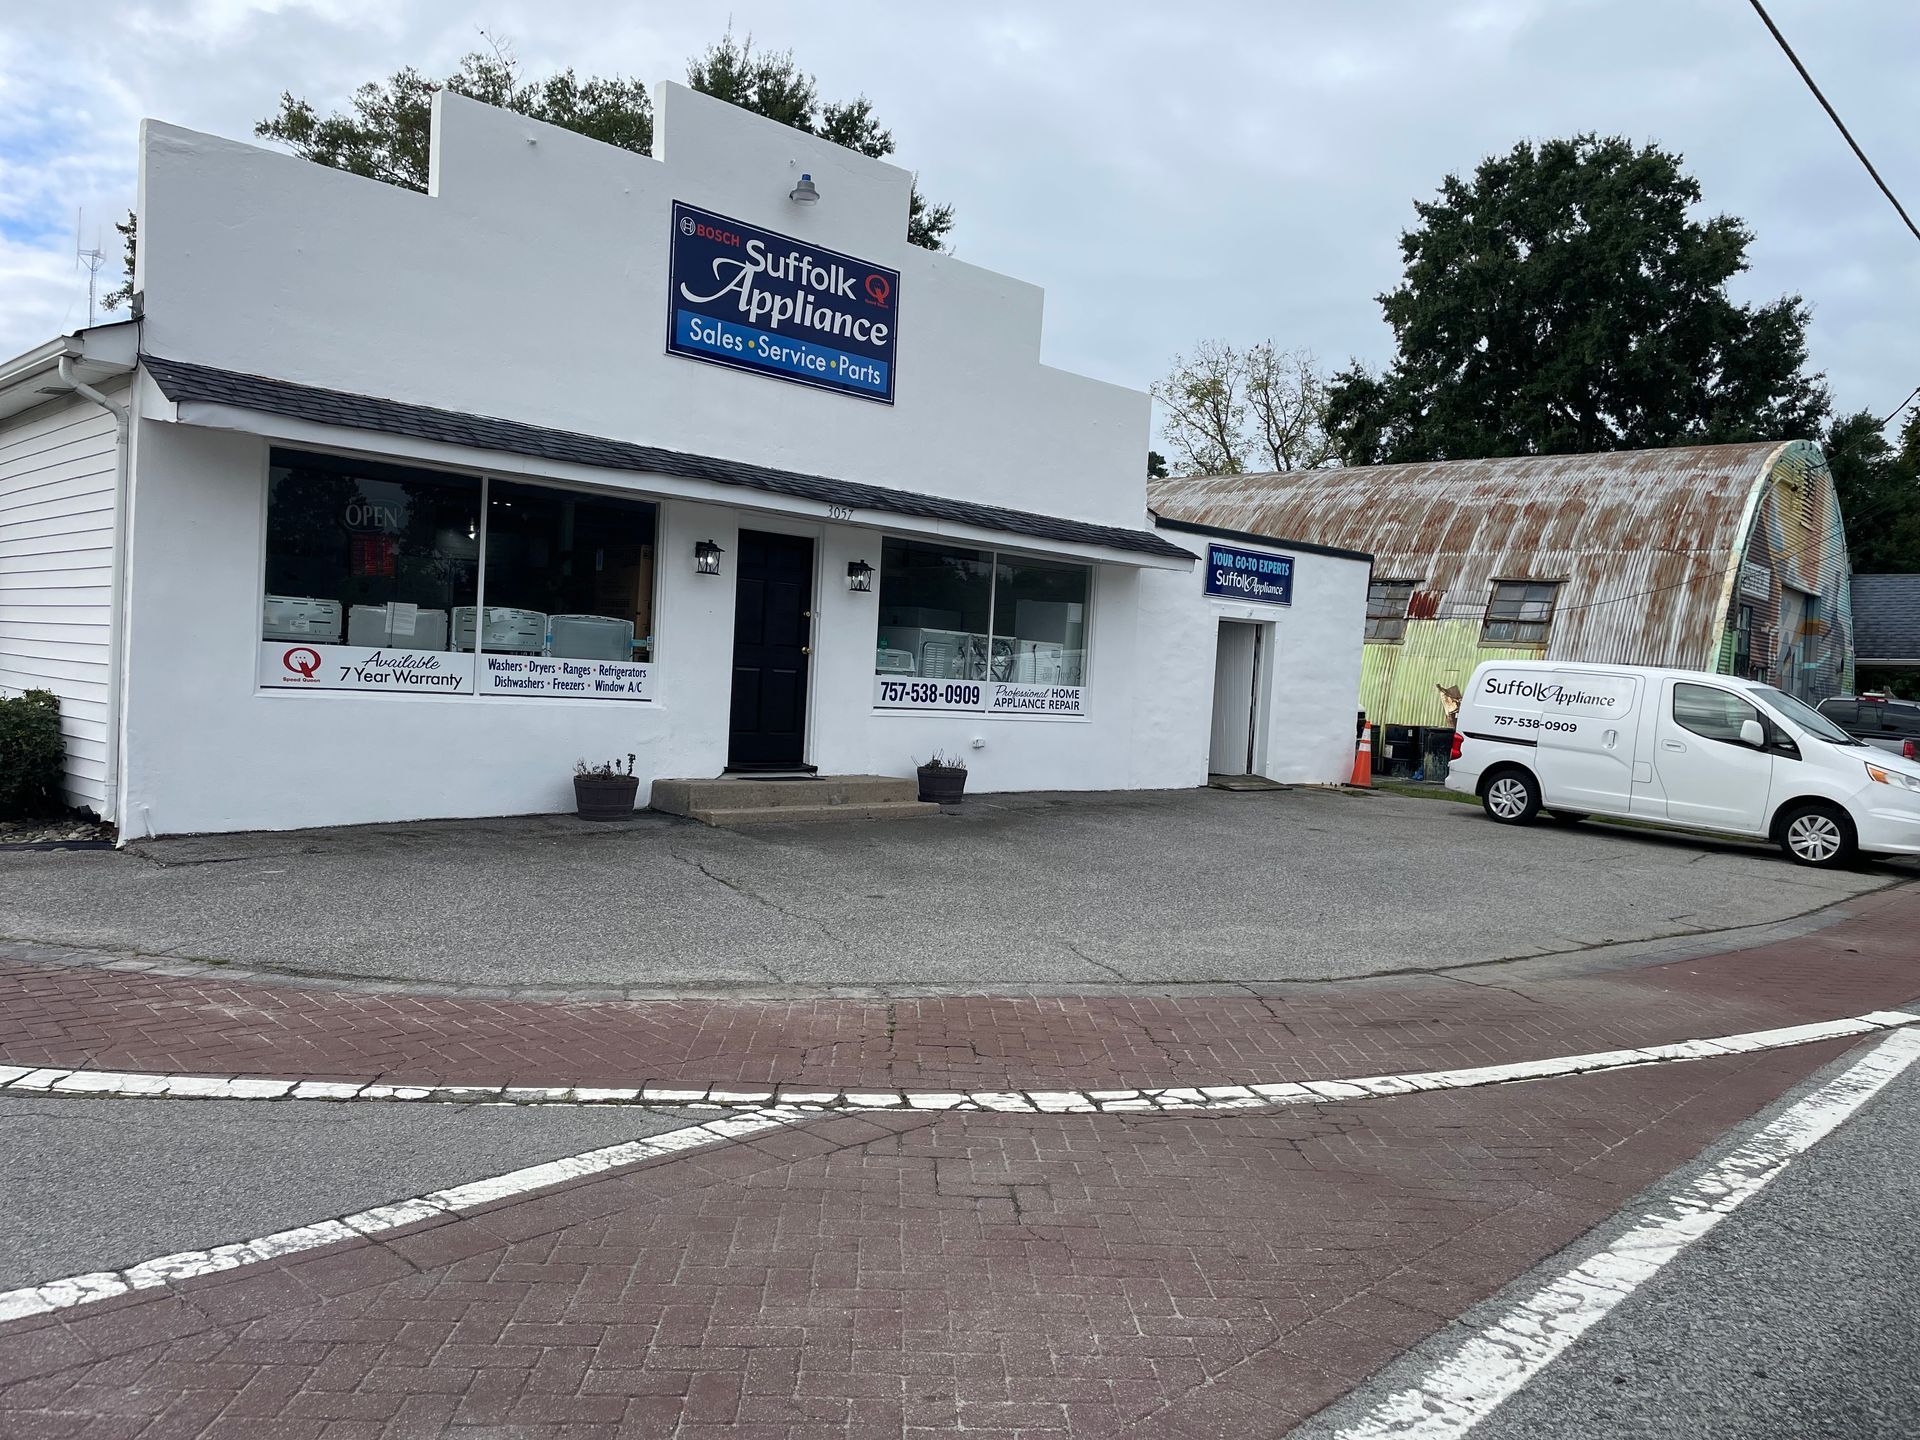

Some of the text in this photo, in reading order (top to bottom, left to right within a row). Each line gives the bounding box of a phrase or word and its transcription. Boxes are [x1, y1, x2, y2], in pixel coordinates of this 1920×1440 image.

[697, 223, 740, 247] BOSCH
[746, 239, 857, 300] Suffolk
[680, 257, 889, 346] Appliance
[689, 317, 881, 385] Sales Service Parts
[345, 504, 398, 528] OPEN
[828, 504, 854, 520] 3057
[1213, 552, 1289, 576] YOUR GO-TO EXPERTS
[1216, 570, 1283, 595] Suffolk Appliance
[361, 650, 441, 671] Available
[488, 658, 647, 680] Washers Dryers Ranges Refrigerators
[340, 666, 463, 691] 7 Year Warranty
[494, 675, 642, 693] Dishwashers Freezers Window A/C
[880, 681, 980, 705] 757-538-0909
[994, 684, 1080, 699] Professional HOME
[1485, 678, 1616, 706] Suffolk Appliance
[993, 697, 1080, 711] APPLIANCE REPAIR
[1494, 715, 1577, 732] 757-538-0909
